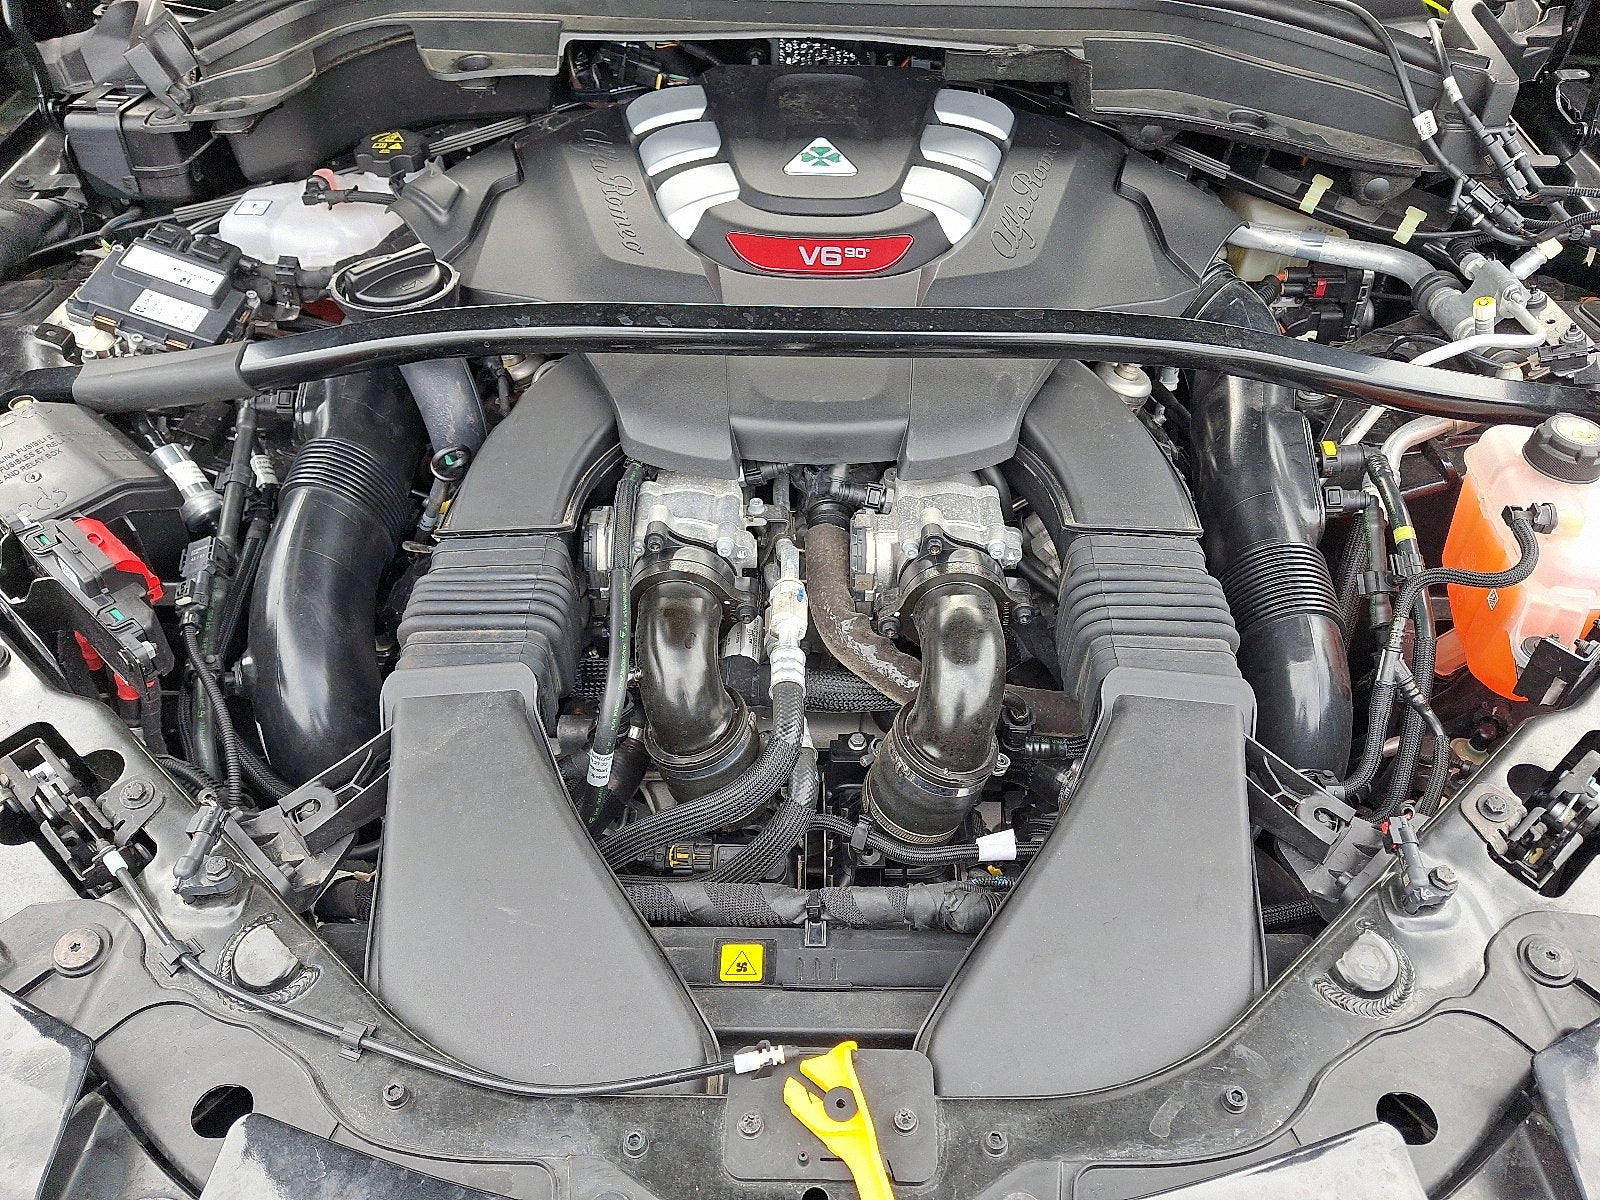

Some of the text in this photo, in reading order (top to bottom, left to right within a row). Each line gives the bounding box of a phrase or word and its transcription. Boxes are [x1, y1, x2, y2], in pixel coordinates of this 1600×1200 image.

[798, 245, 843, 267] V6
[15, 438, 48, 455] FUSIBILI
[34, 445, 46, 455] ET
[3, 448, 63, 481] AND RELAY BOX
